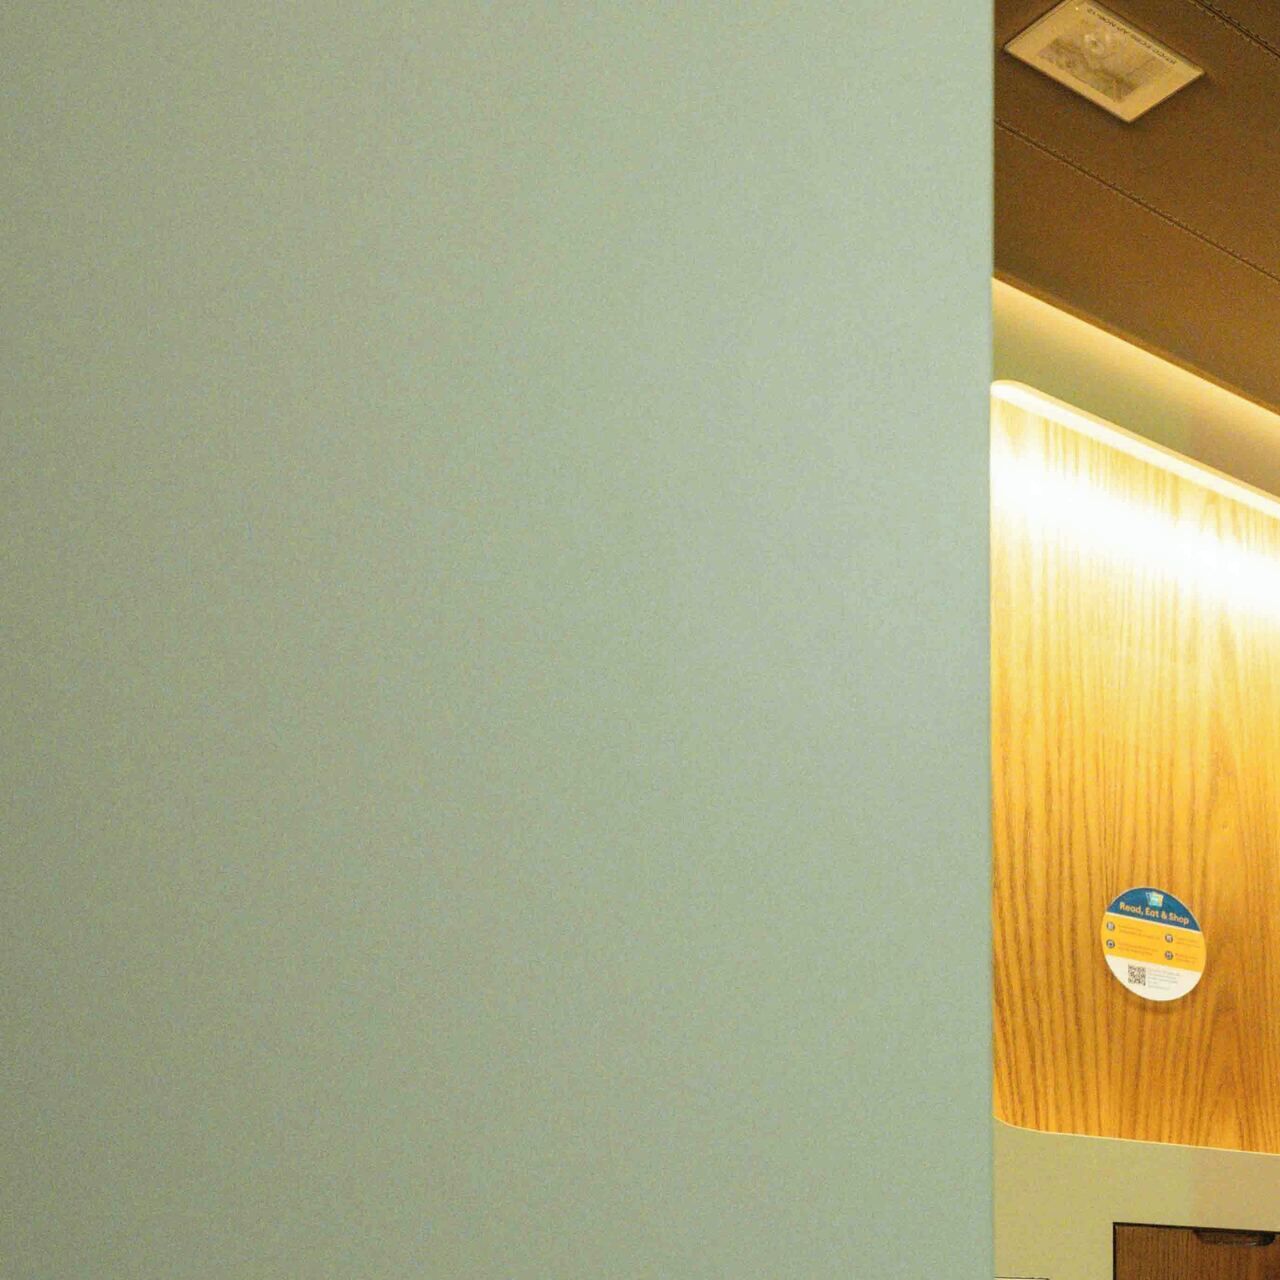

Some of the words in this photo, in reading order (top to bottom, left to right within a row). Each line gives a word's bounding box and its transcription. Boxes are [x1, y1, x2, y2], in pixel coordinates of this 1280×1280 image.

[1119, 902, 1144, 916] Read,
[1145, 908, 1160, 918] Eat
[1161, 911, 1168, 920] &
[1169, 912, 1190, 925] Shop
